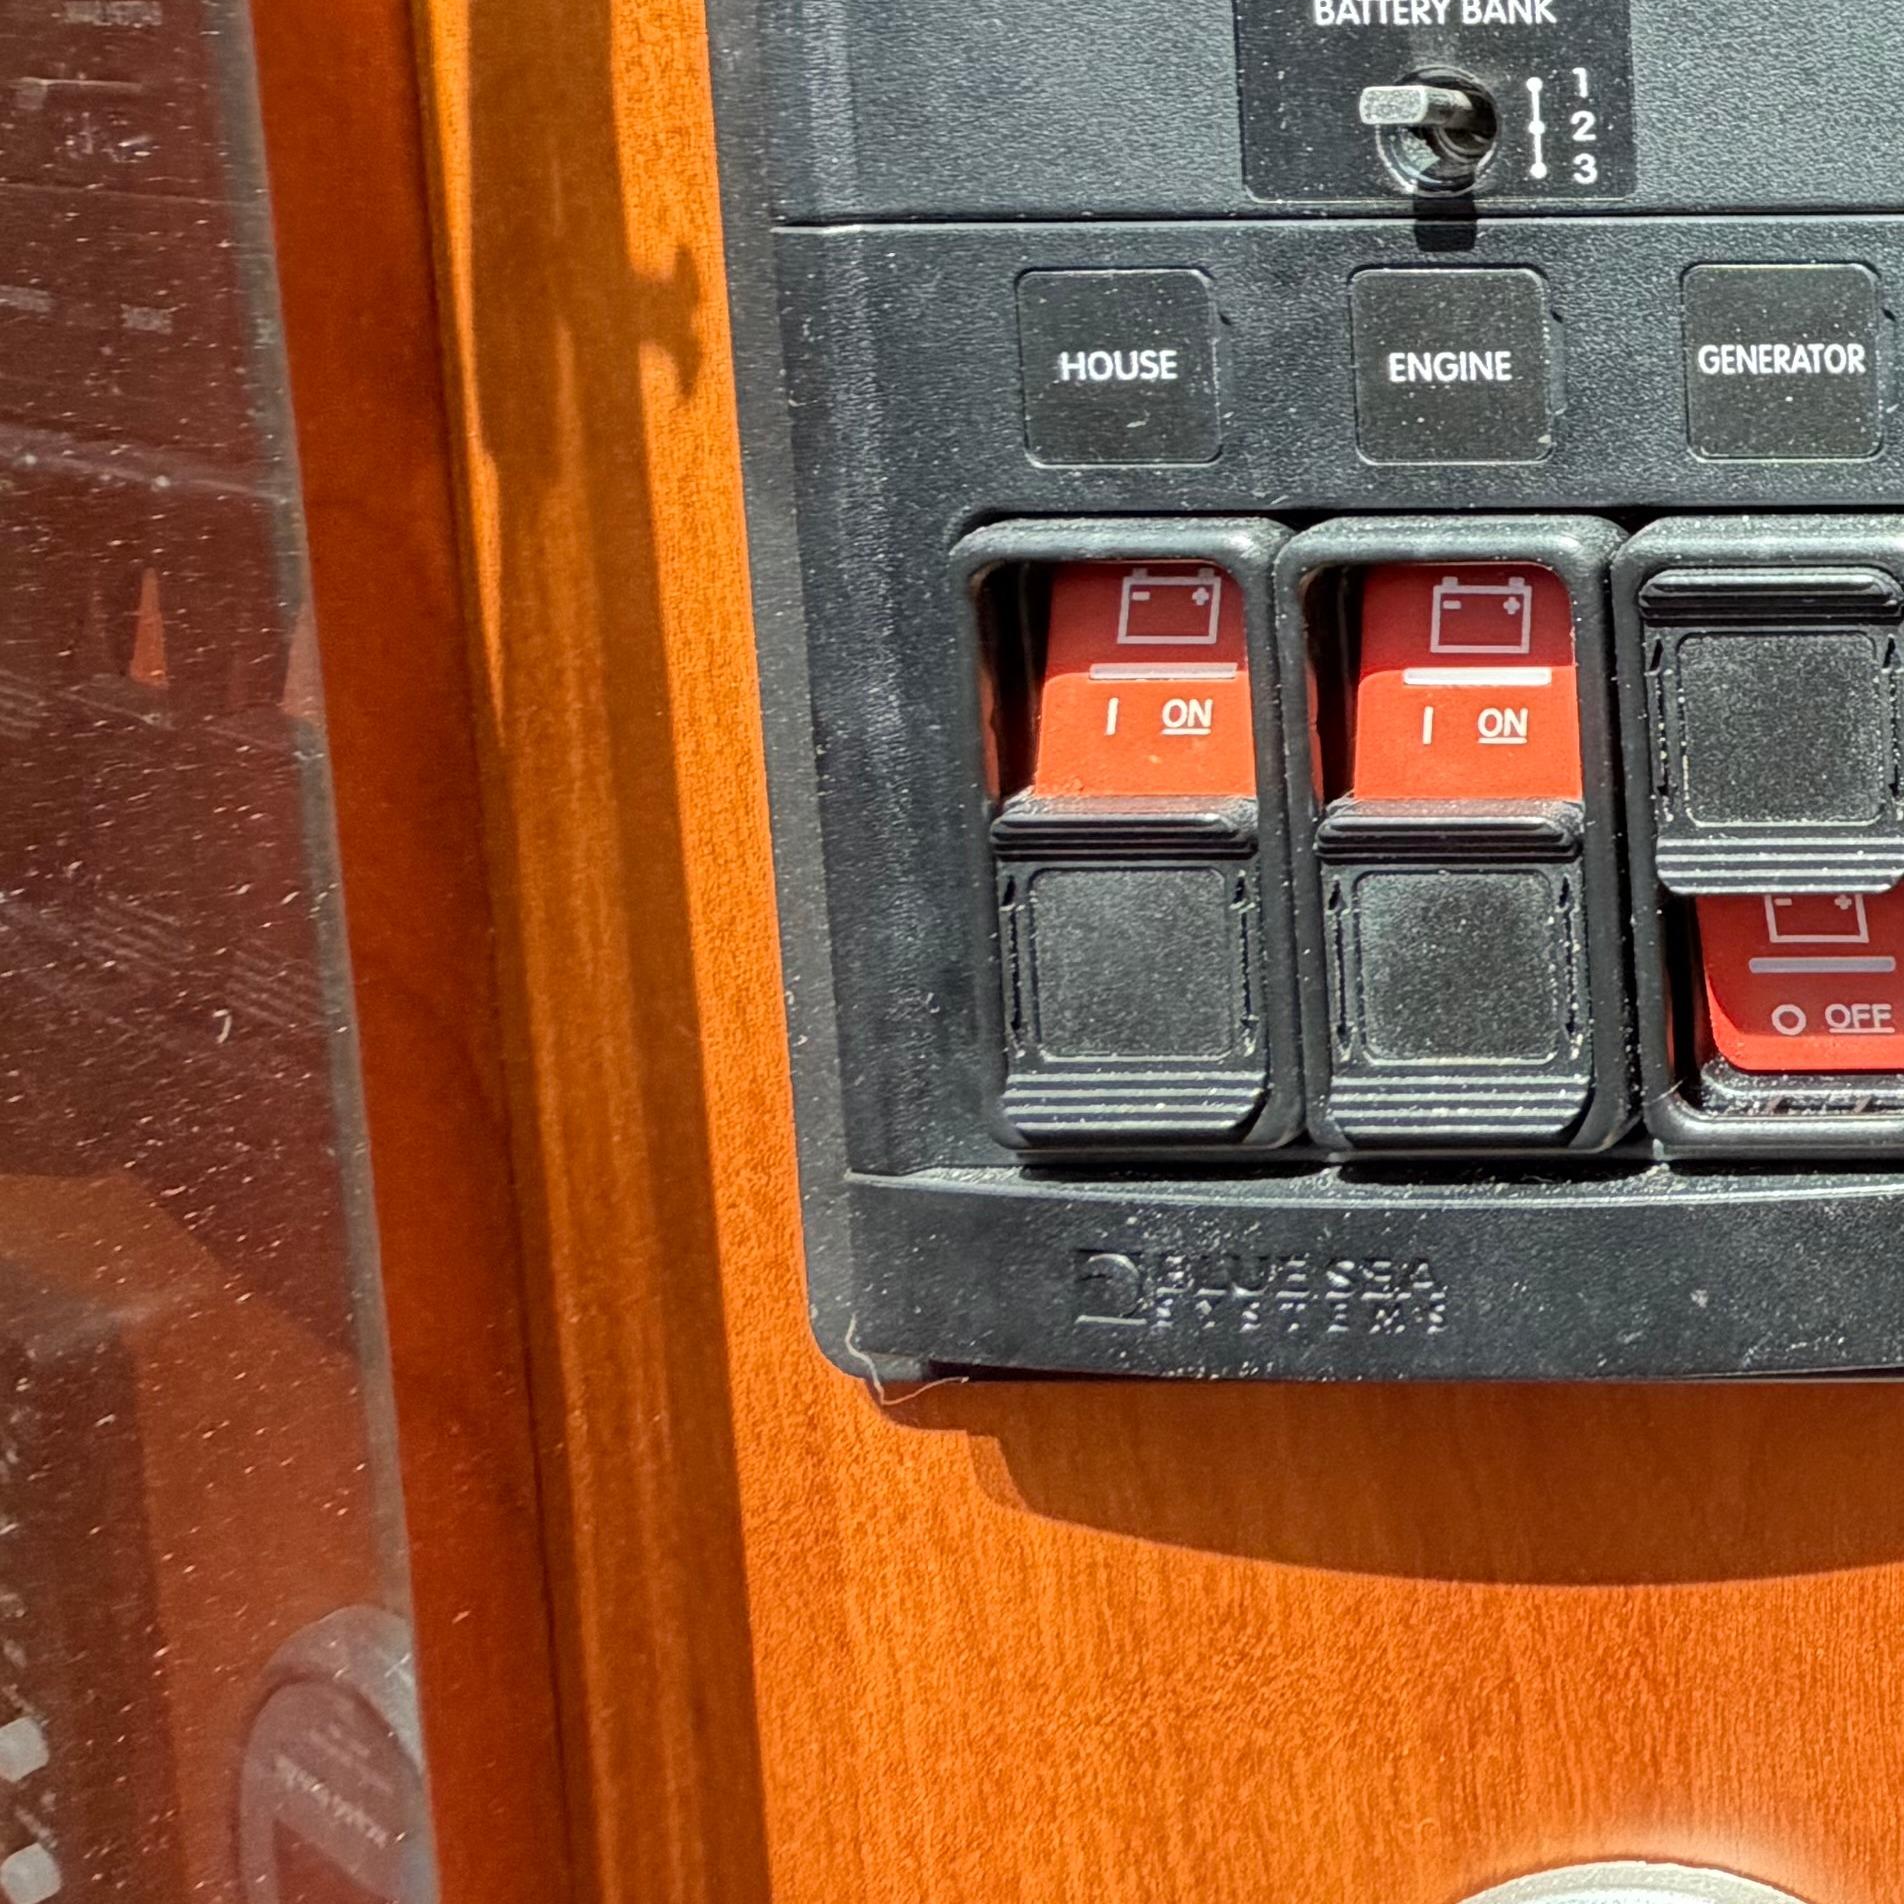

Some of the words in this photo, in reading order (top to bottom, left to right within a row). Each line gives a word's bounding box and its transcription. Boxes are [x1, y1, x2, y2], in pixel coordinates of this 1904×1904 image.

[1571, 67, 1589, 99] 1
[1569, 110, 1597, 142] 2
[1572, 152, 1598, 185] 3
[1058, 349, 1178, 383] HOUSE
[1388, 350, 1513, 383] ENGINE
[1697, 343, 1866, 376] GENERATOR
[1160, 697, 1213, 735] ON
[1477, 707, 1528, 744] ON
[1824, 1001, 1895, 1036] OFF
